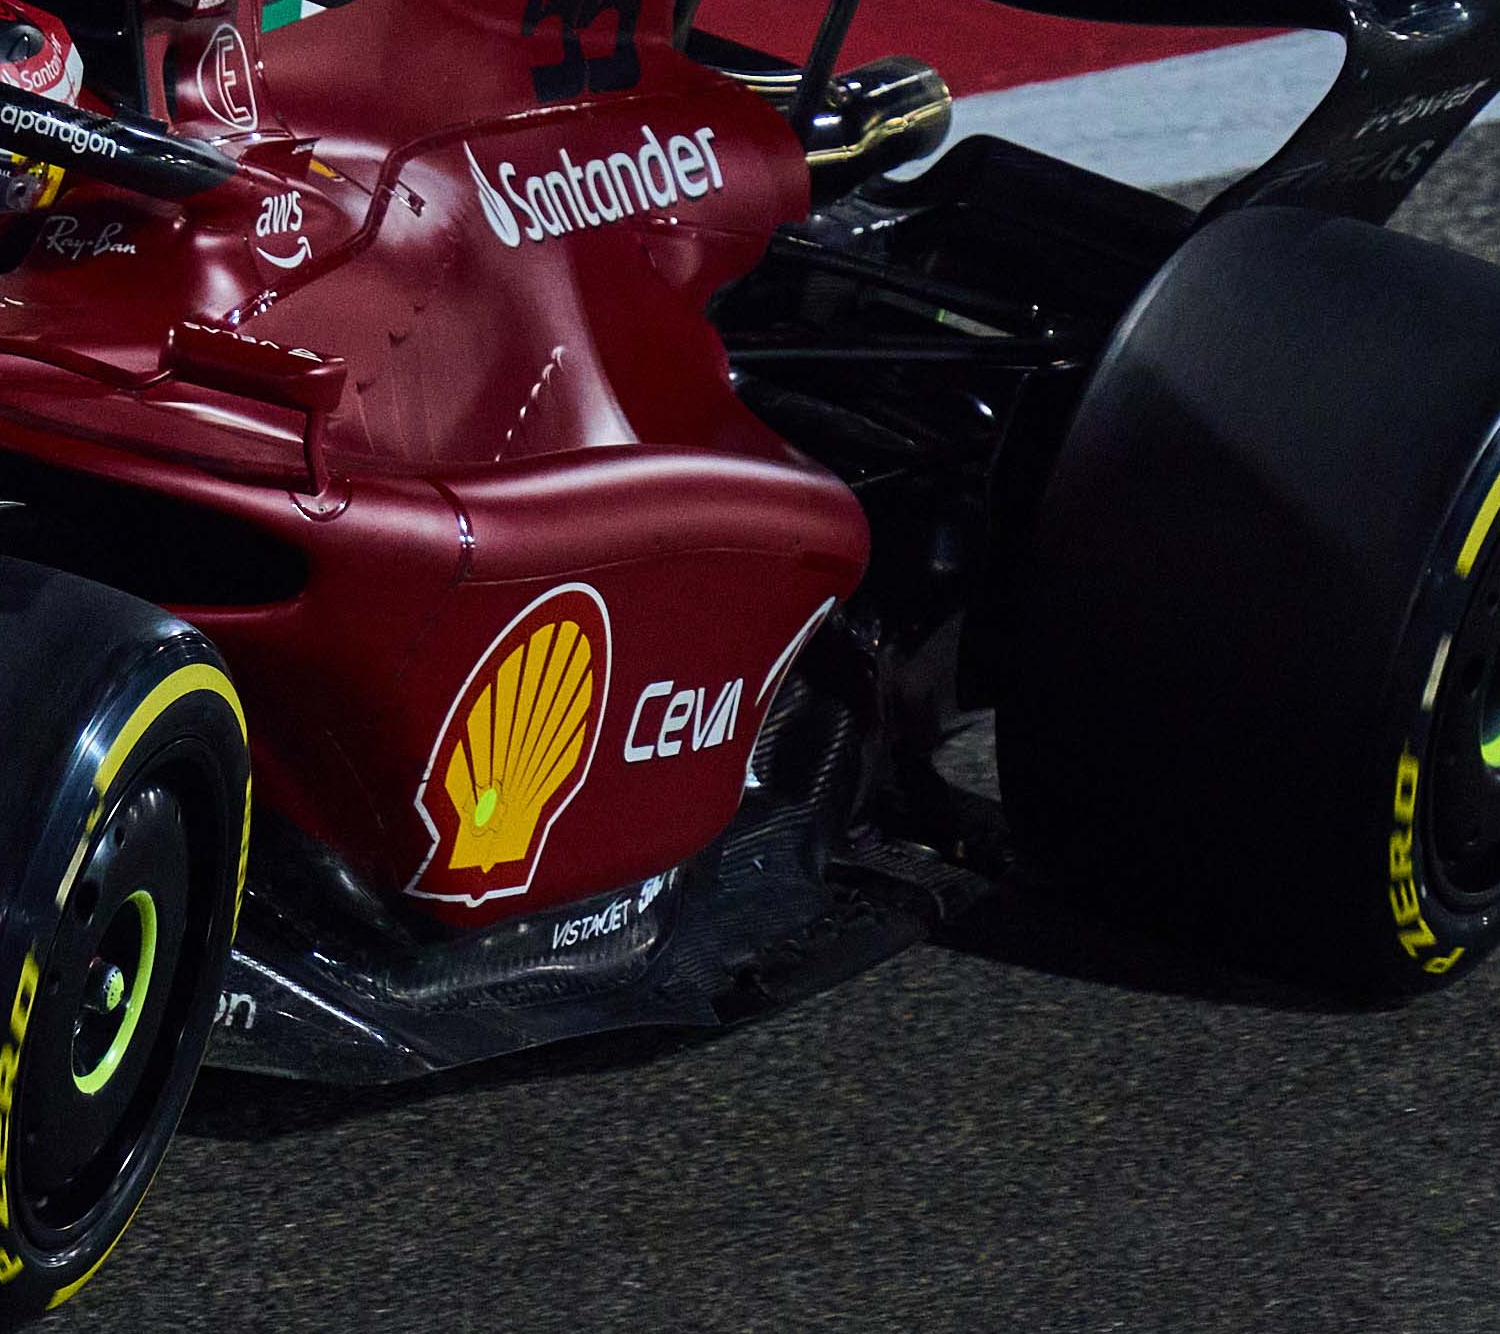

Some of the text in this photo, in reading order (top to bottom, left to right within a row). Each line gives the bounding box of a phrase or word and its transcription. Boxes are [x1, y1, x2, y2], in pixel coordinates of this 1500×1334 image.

[256, 190, 302, 237] aws
[507, 125, 723, 244] Santander
[1389, 753, 1437, 959] ZERO
